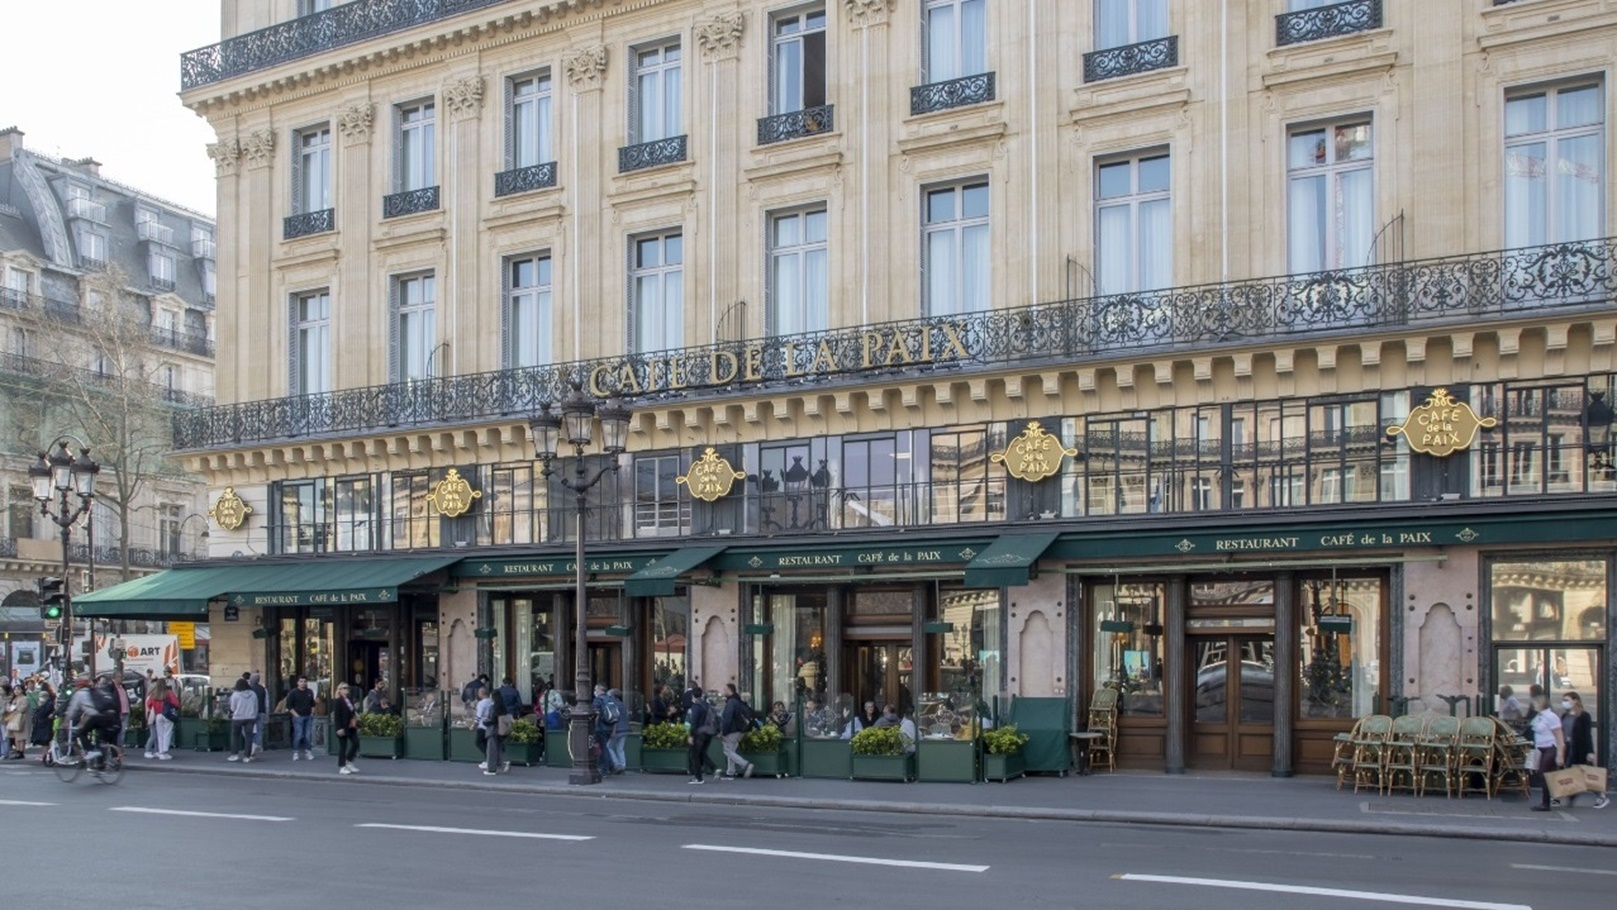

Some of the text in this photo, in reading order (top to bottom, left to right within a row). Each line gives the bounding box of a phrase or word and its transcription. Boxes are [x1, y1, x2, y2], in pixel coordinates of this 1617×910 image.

[710, 347, 762, 385] DE
[785, 338, 840, 376] LA
[861, 322, 969, 368] PAIX
[1426, 422, 1453, 432] de la
[1422, 431, 1460, 446] PAIX
[1019, 460, 1049, 472] PAIX
[698, 481, 722, 493] PAIX
[442, 499, 463, 509] PAIX
[1216, 532, 1431, 550] RESTAURANT CAFÉ de la PAIX
[778, 551, 941, 565] RESTAURANT CAFÉ de la PAIX
[504, 561, 632, 573] RESTAURANT CA de la PAIX
[255, 595, 299, 604] RESTAURANT
[140, 647, 160, 656] ART
